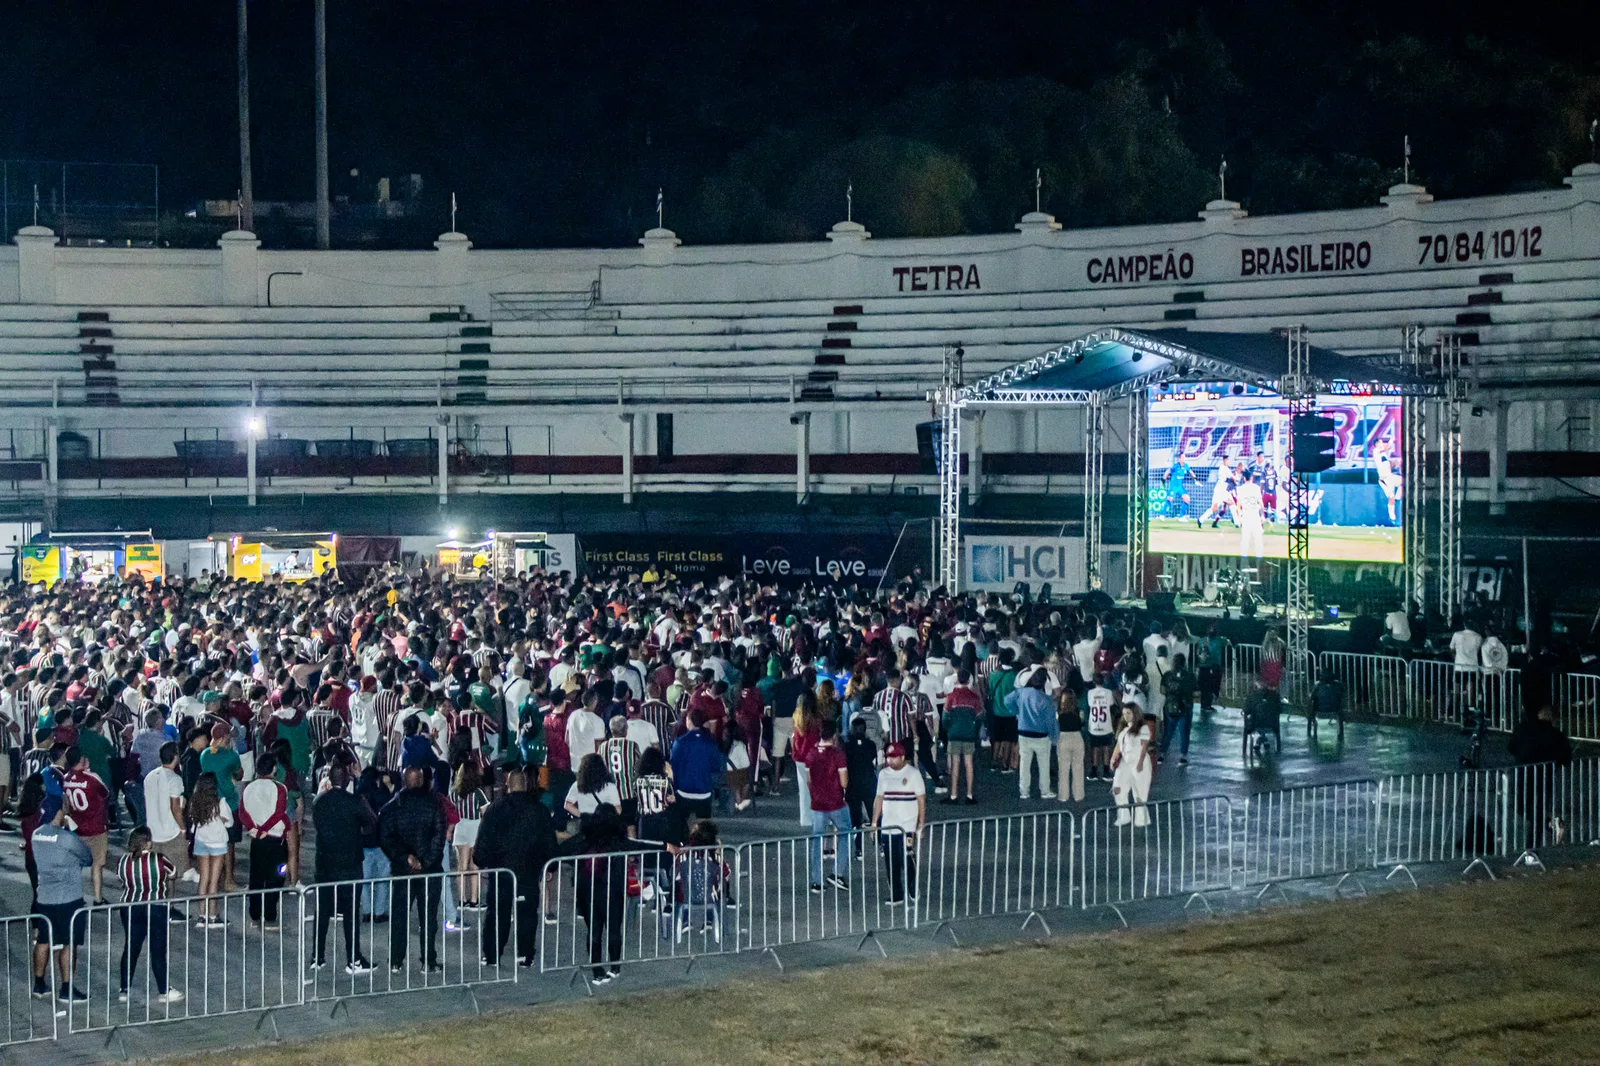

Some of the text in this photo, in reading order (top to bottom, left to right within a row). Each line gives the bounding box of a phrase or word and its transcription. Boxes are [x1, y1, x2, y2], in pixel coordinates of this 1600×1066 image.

[893, 264, 981, 292] TETRA
[1087, 248, 1194, 283] CAMPEÃO
[1241, 241, 1371, 276] BRASILEIRO
[585, 551, 650, 562] First Class
[657, 551, 723, 562] First Class
[742, 555, 791, 575] Leve
[815, 555, 866, 576] Leve
[1007, 545, 1065, 579] HCI
[1091, 706, 1107, 723] 95
[611, 752, 622, 773] 9
[66, 788, 88, 811] 10
